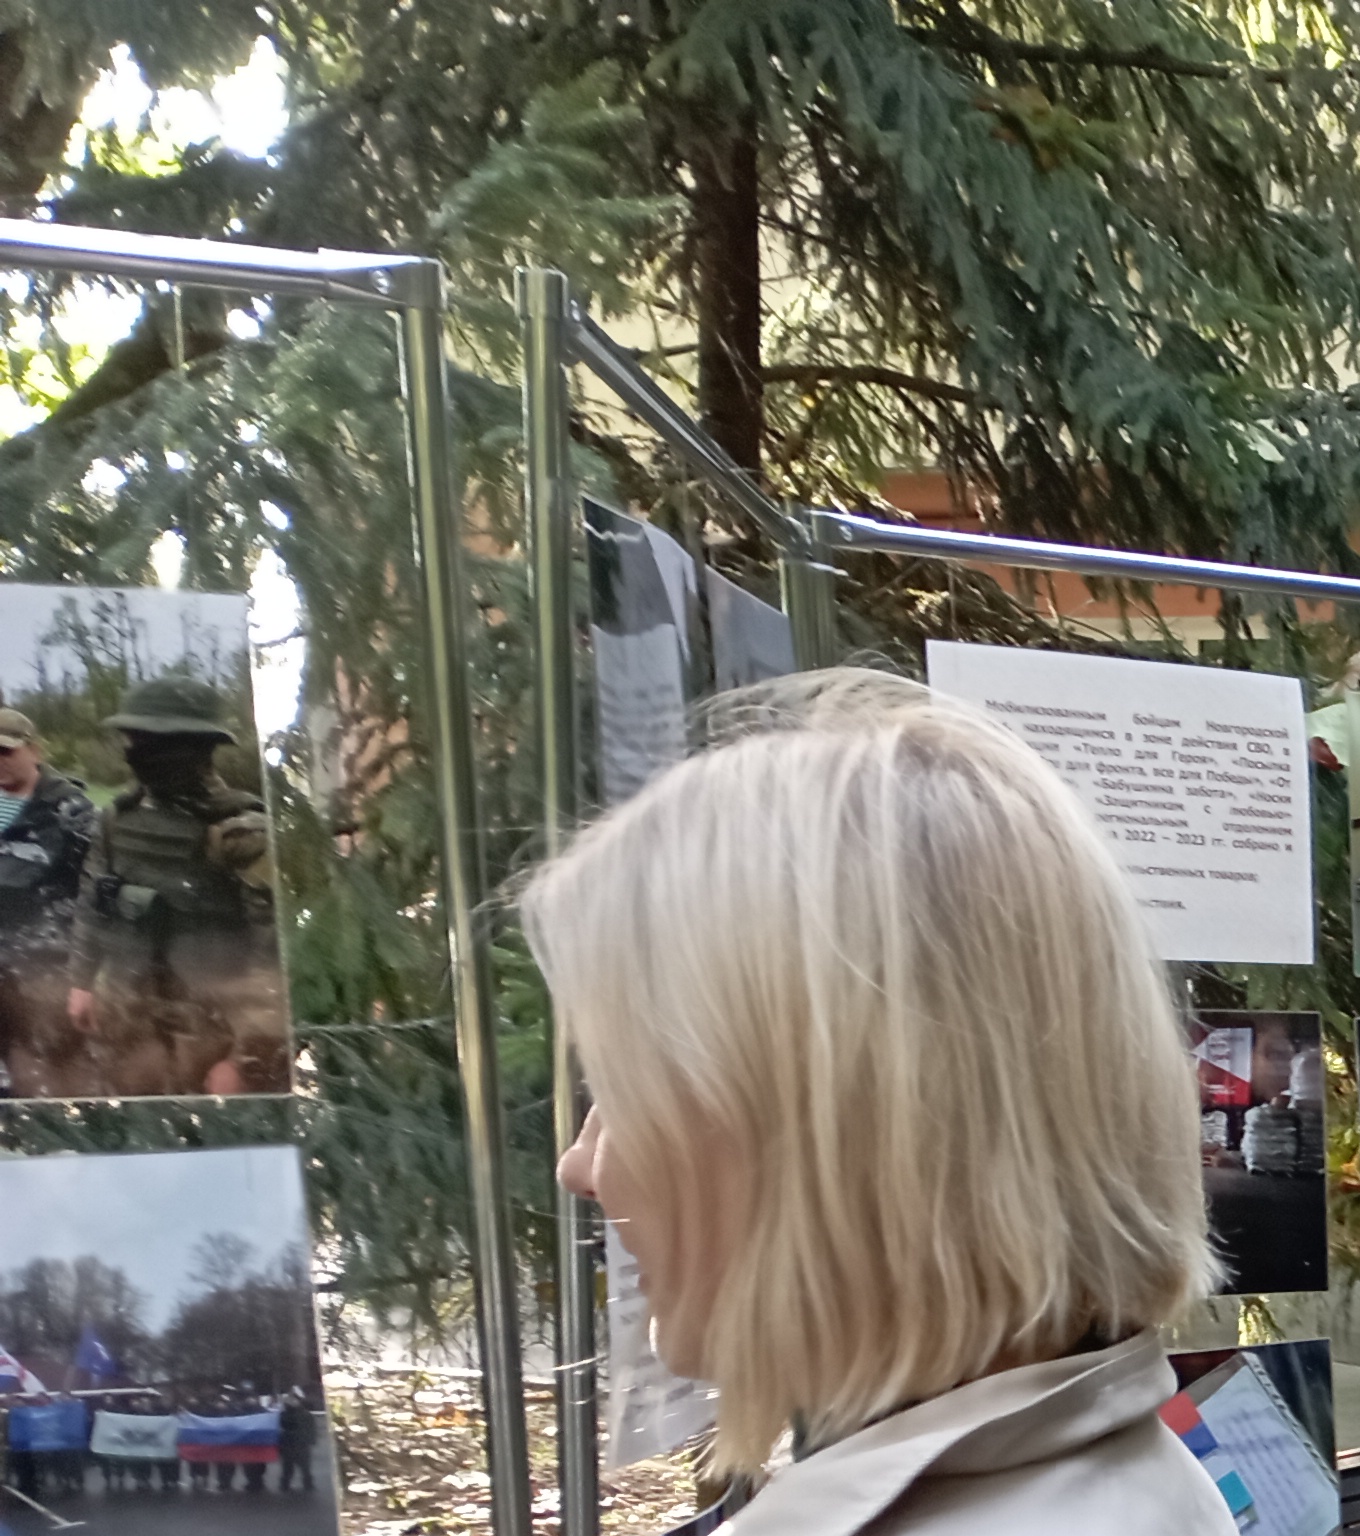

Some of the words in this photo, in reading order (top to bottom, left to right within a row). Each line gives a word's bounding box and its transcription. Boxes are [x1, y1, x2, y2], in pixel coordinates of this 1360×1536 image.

[985, 699, 1106, 720] Мобилизованным
[1206, 720, 1289, 739] Новгородской
[1143, 734, 1172, 745] зоне
[1125, 829, 1155, 842] 2022
[1176, 832, 1205, 846] 2023
